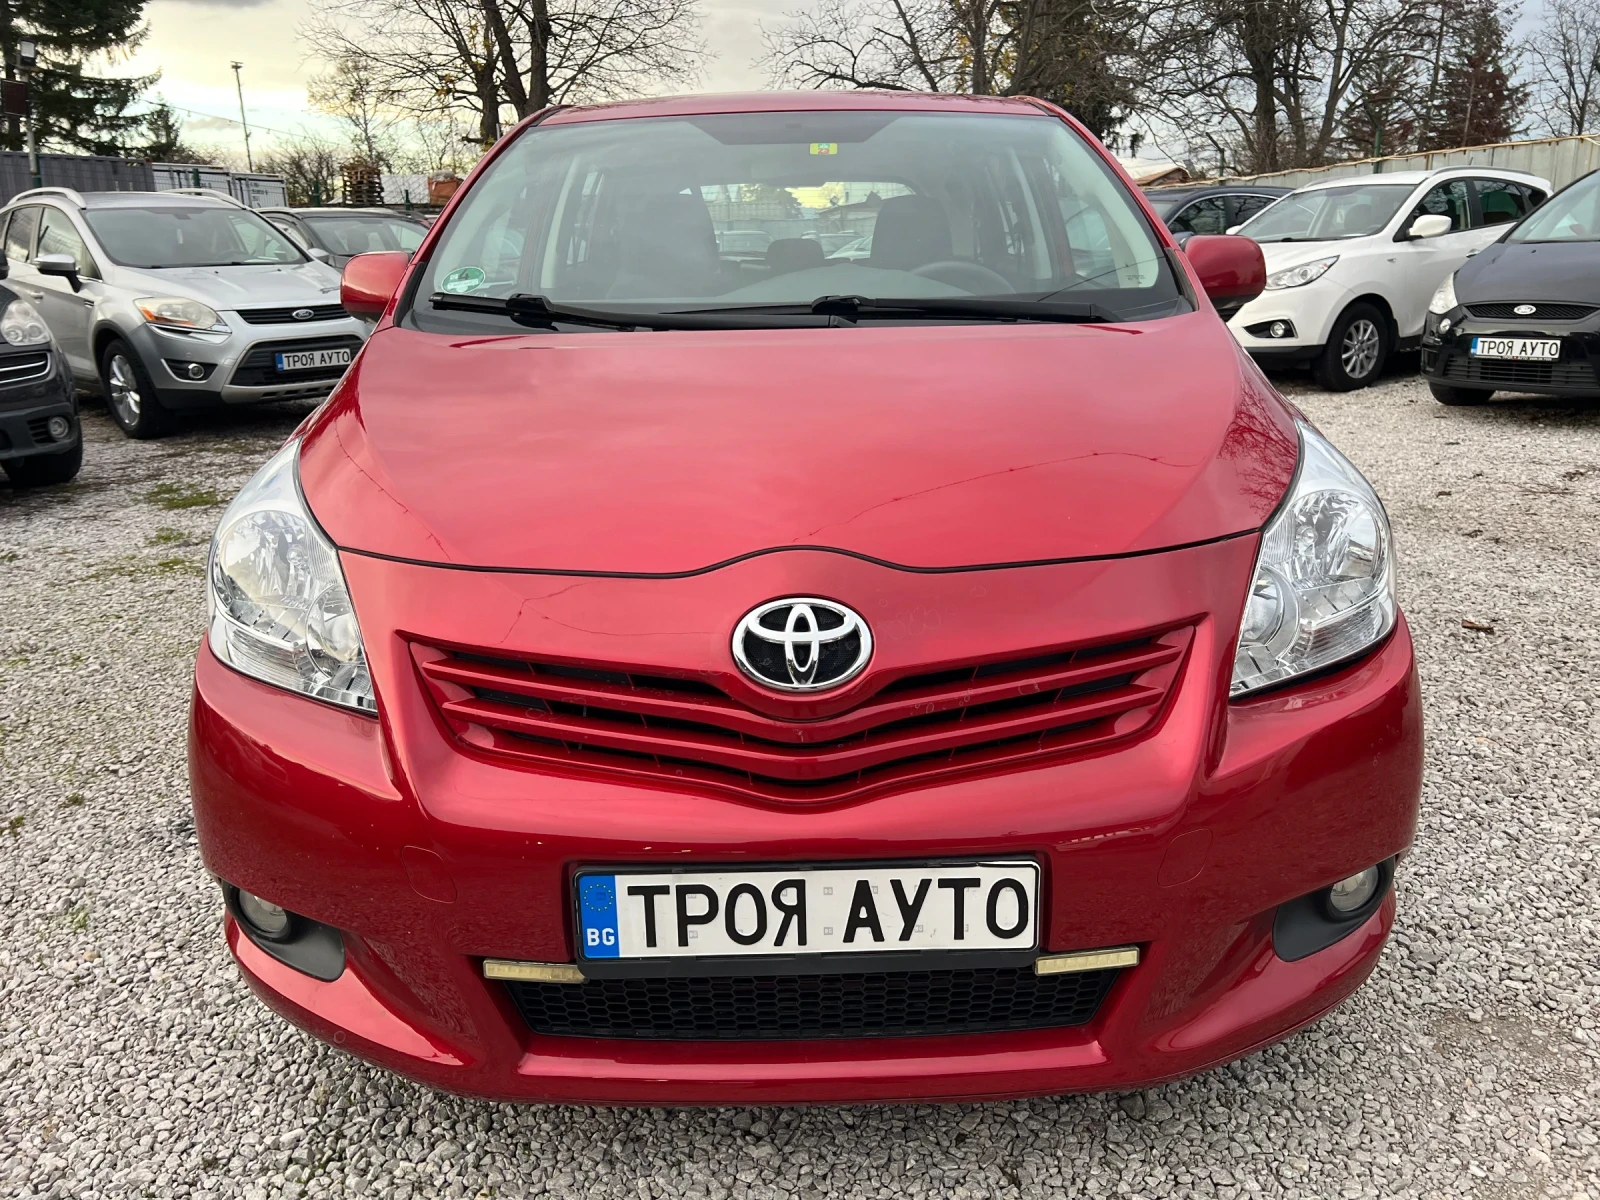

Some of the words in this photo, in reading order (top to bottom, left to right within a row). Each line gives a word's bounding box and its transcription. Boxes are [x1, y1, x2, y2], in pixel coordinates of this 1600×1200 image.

[458, 269, 469, 280] 4
[1480, 340, 1514, 355] ТРОЯ
[1519, 341, 1559, 357] АУТО
[284, 352, 315, 368] ТРОЯ
[320, 350, 350, 365] АУТО
[627, 879, 807, 948] ТРОЯ
[842, 877, 1029, 943] АУТО
[586, 927, 615, 946] BG
